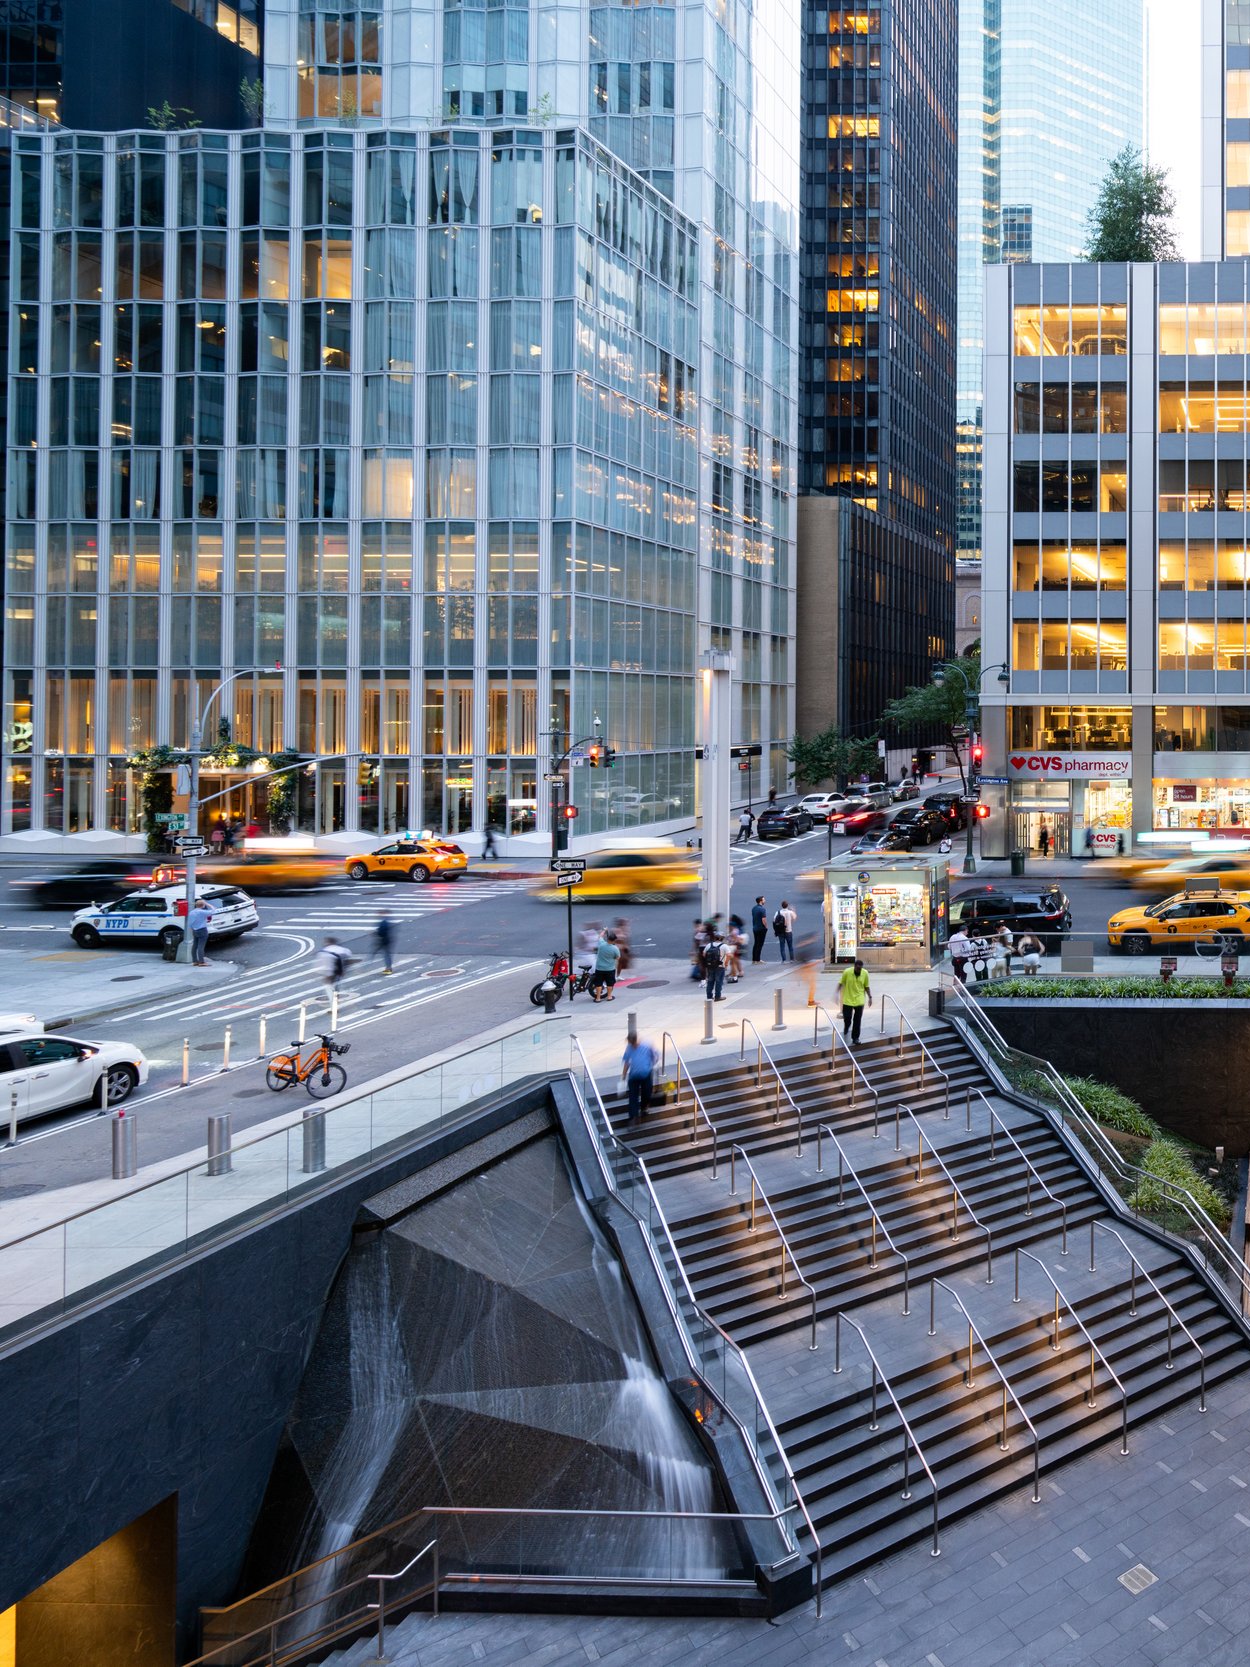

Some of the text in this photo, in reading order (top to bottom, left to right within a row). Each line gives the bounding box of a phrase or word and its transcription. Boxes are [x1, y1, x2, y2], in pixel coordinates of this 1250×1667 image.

[1027, 756, 1129, 774] CVS pharmacy
[1096, 834, 1116, 843] CVS
[105, 919, 130, 929] NYPD
